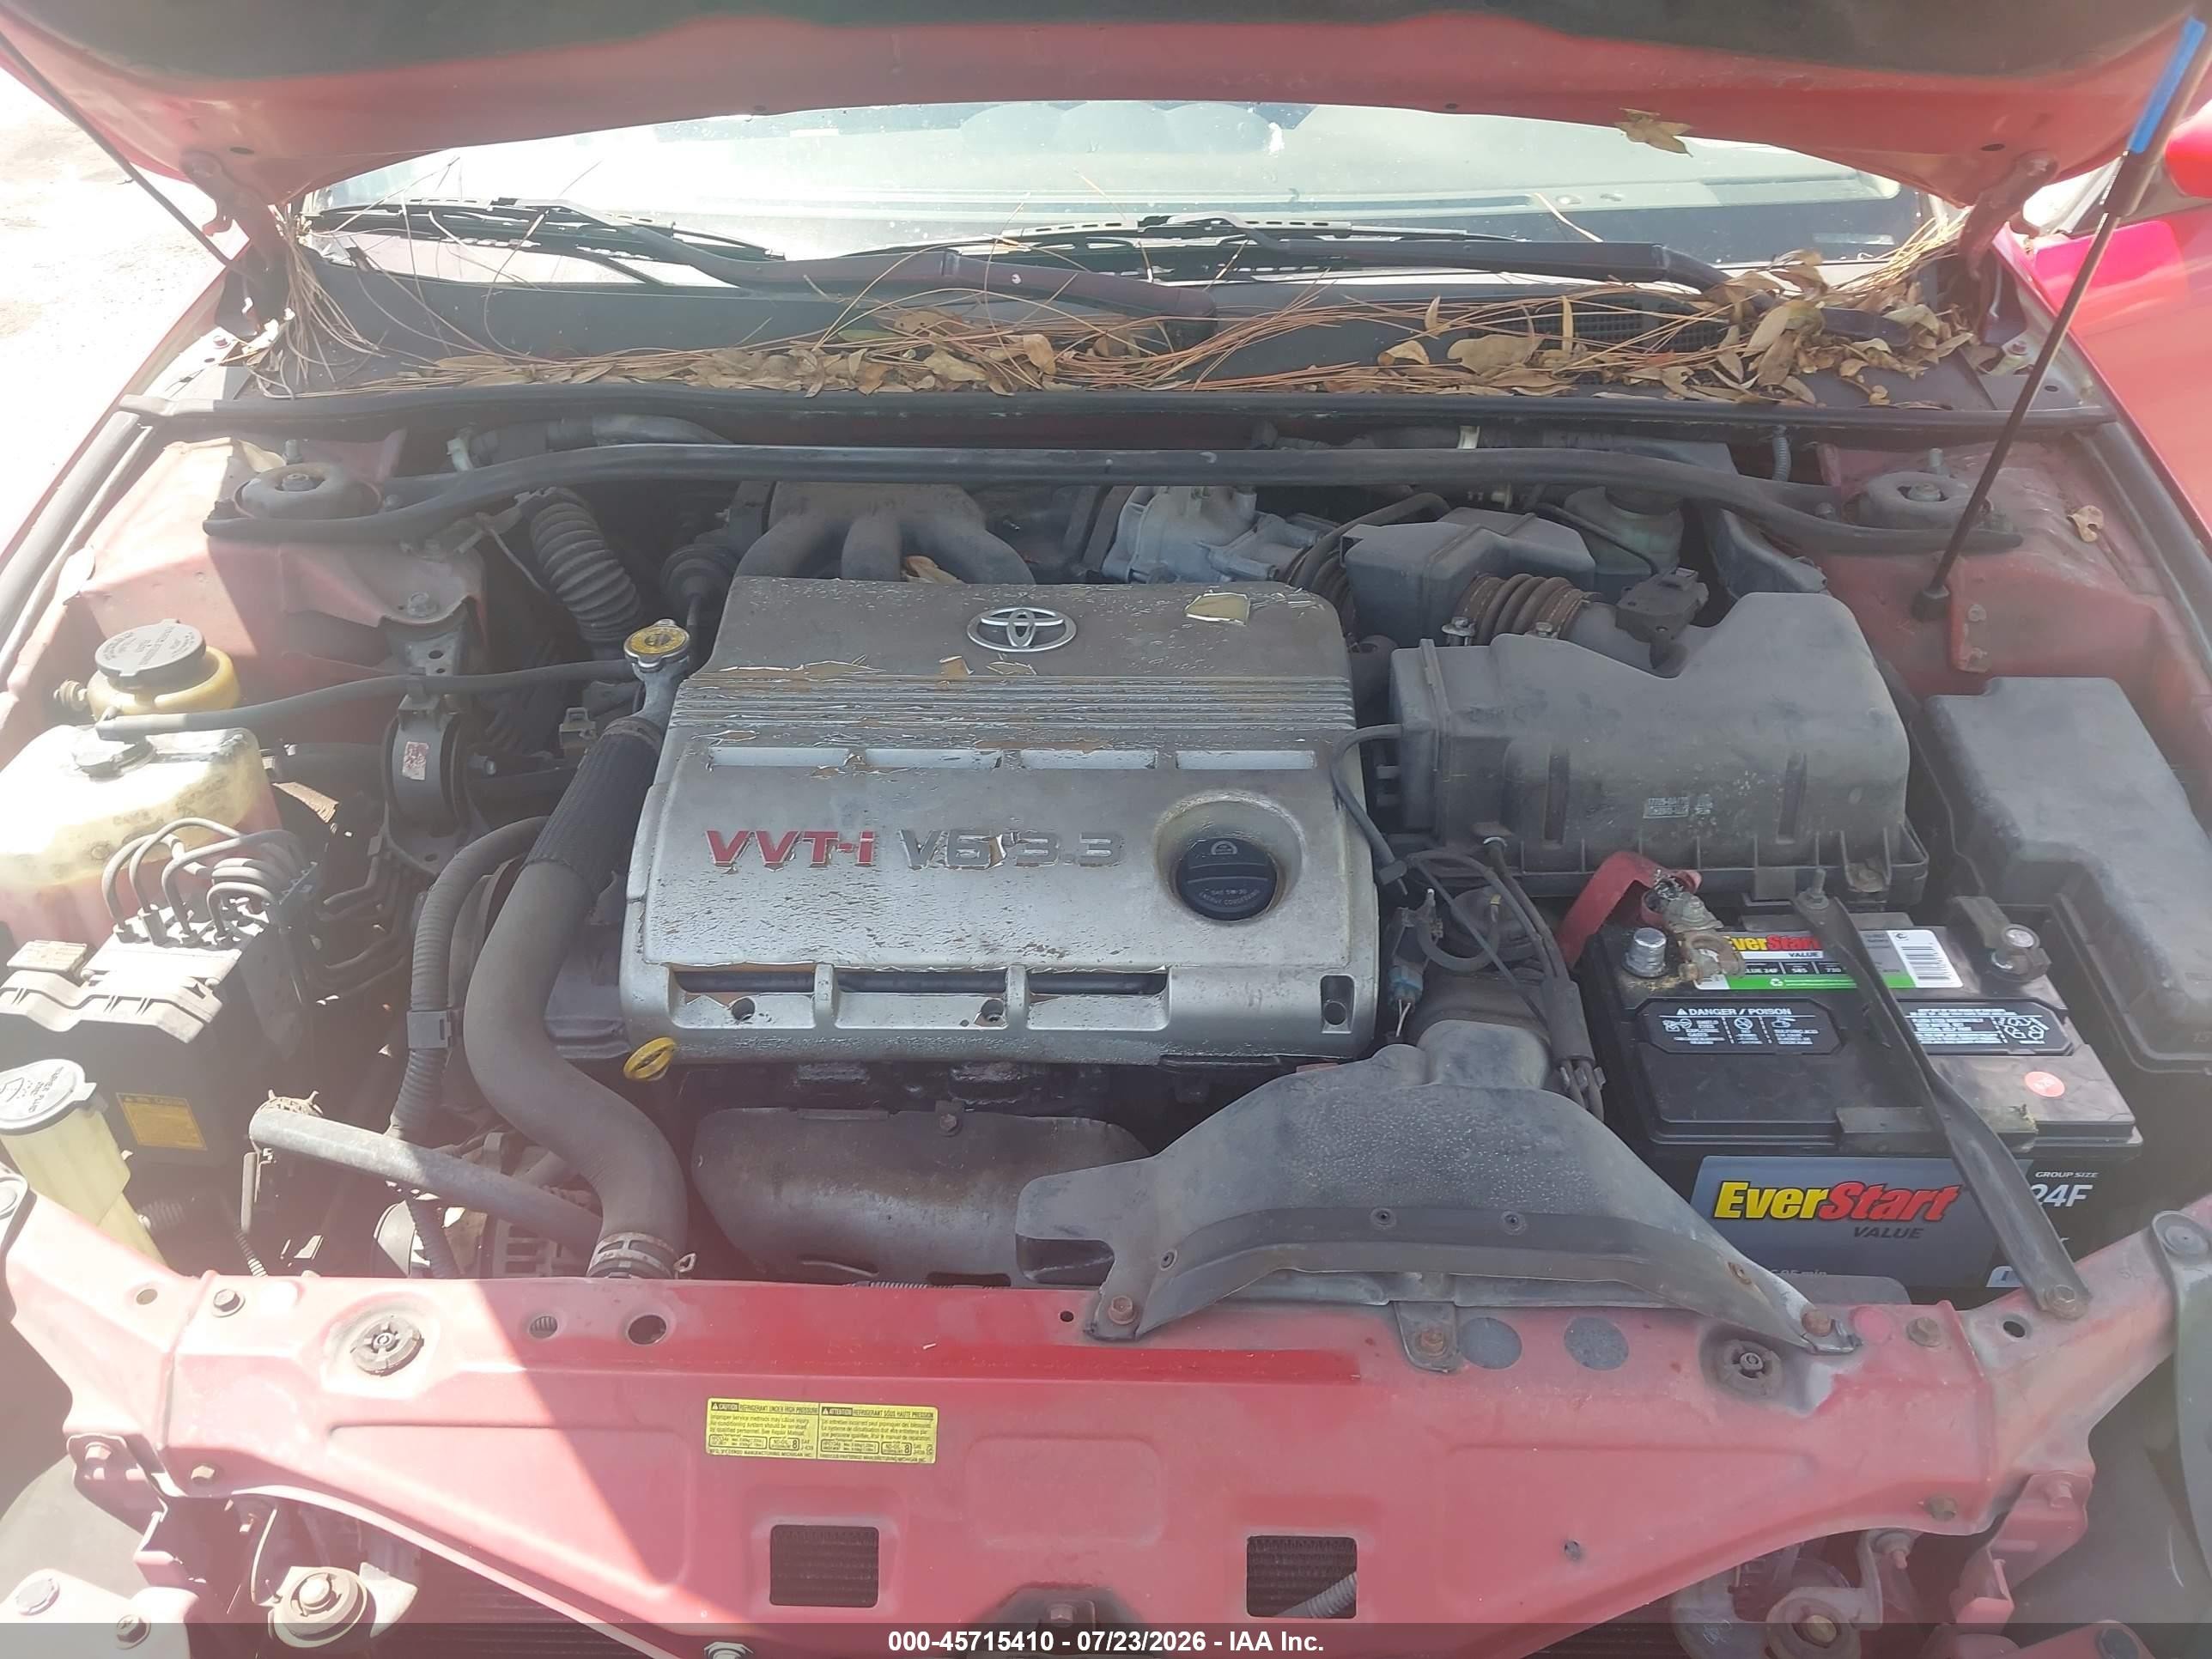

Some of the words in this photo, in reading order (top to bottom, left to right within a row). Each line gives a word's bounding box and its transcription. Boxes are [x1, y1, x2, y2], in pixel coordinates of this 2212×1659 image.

[704, 830, 876, 866] VVT-i
[900, 830, 991, 869] V6
[1713, 1181, 1963, 1222] EverStart
[2030, 1184, 2094, 1207] 24F
[1853, 1226, 1925, 1239] VALUE
[793, 1440, 798, 1449] 8
[904, 1443, 909, 1454] 8
